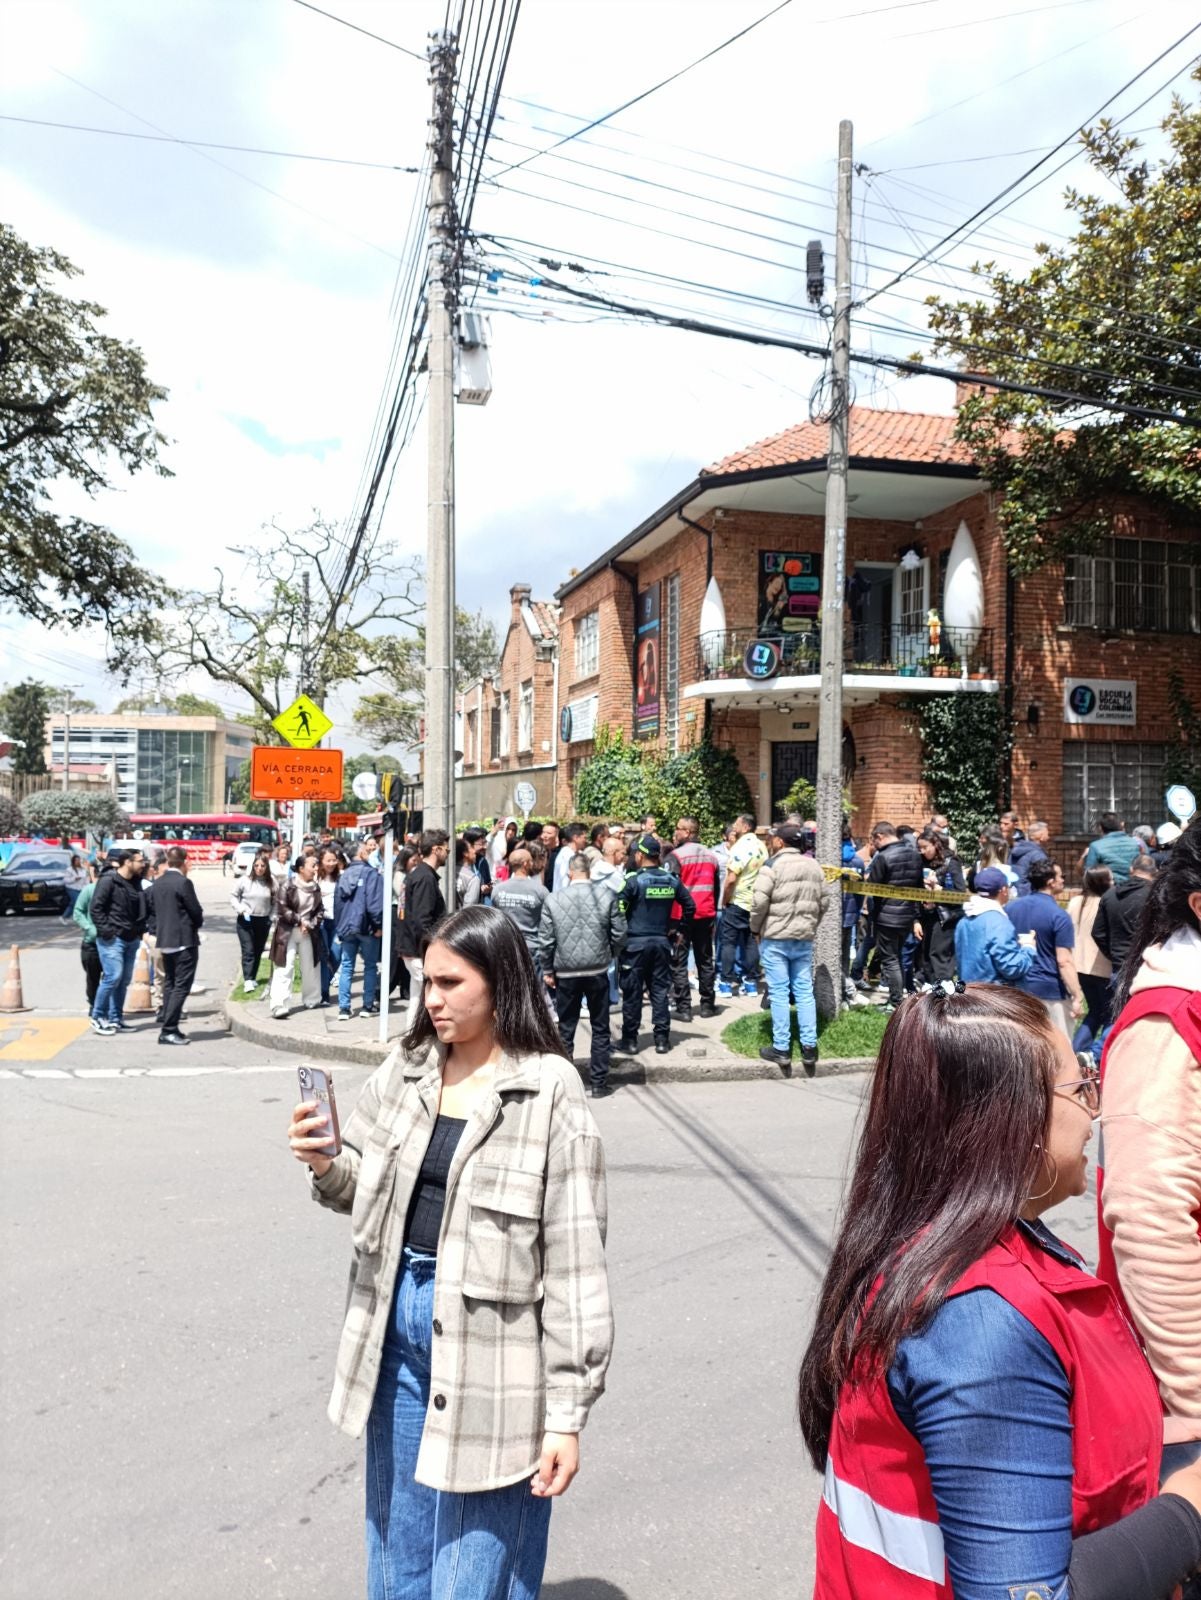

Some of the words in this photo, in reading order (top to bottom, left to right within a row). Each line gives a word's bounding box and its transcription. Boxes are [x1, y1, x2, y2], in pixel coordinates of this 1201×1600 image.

[284, 764, 333, 774] CERRADA
[275, 776, 283, 785] A
[290, 776, 304, 785] 50
